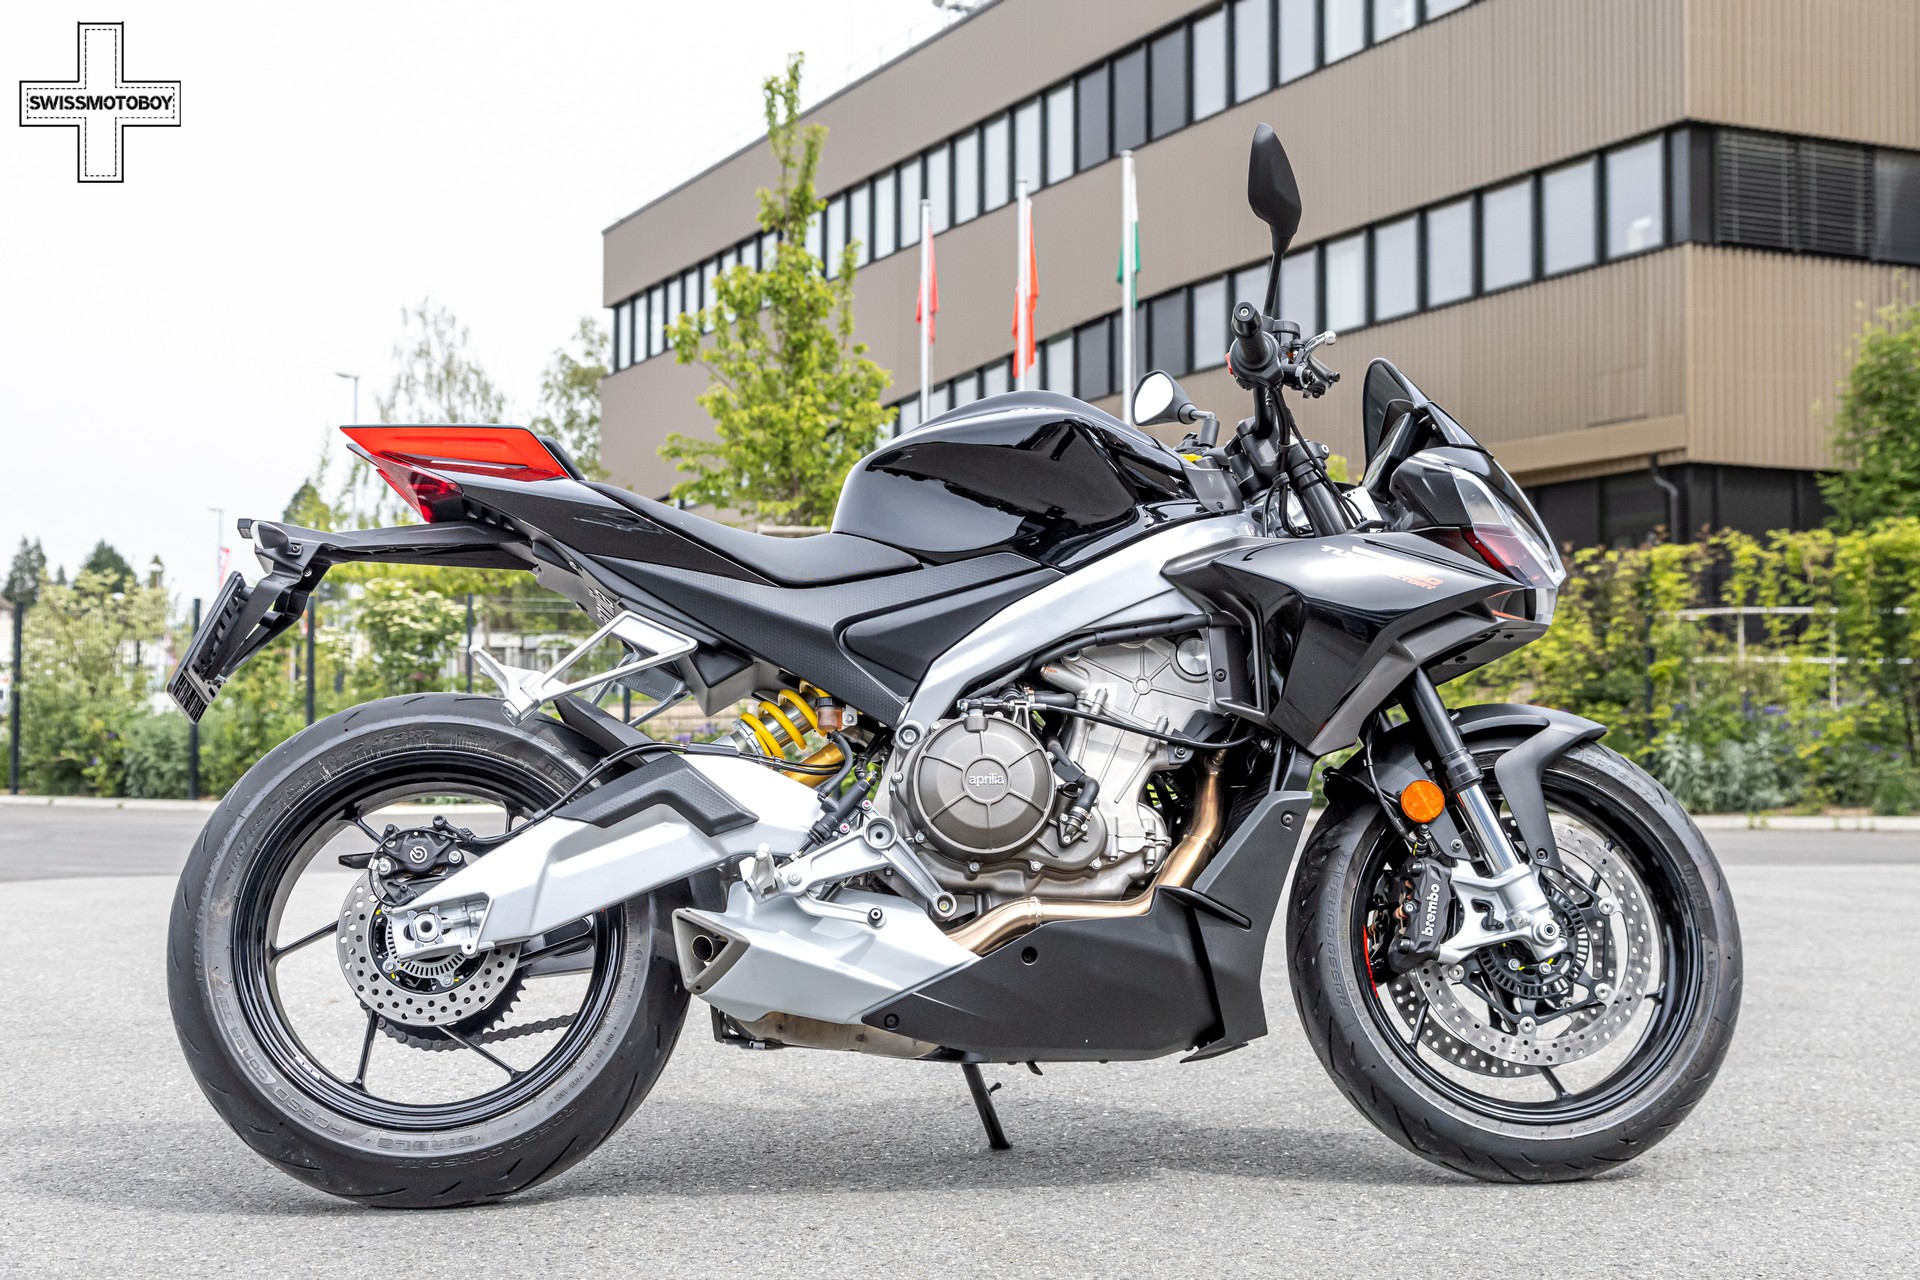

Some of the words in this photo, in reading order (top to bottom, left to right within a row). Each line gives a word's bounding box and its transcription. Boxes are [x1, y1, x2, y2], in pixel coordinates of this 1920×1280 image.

[968, 772, 1005, 788] aprilia
[1325, 875, 1343, 939] CORSA
[1421, 883, 1440, 937] brembo
[1326, 943, 1350, 1010] ROSSO
[230, 1026, 269, 1086] CORSA
[273, 1086, 346, 1136] ROSSO
[376, 1134, 476, 1153] DIABLO
